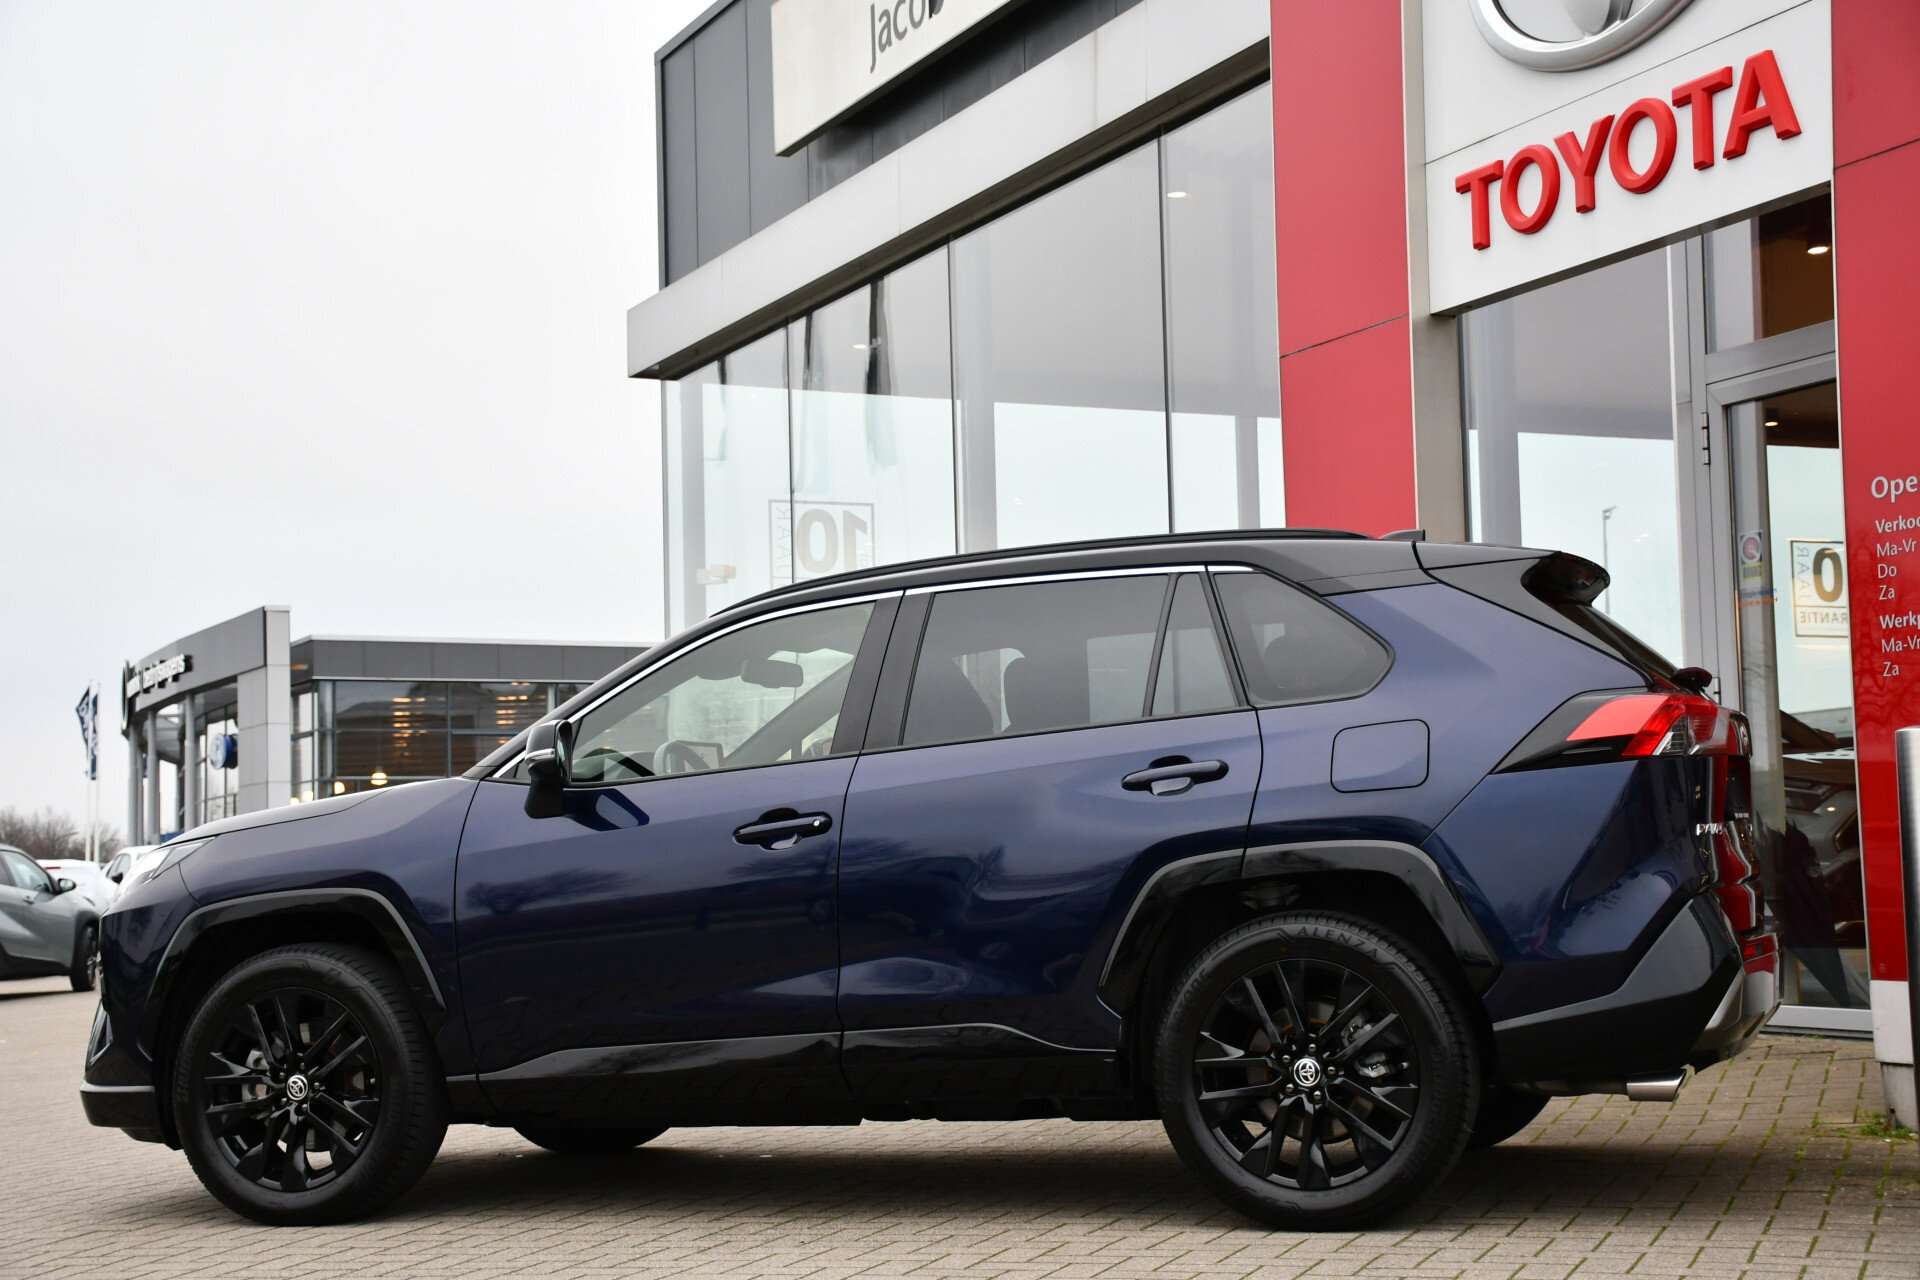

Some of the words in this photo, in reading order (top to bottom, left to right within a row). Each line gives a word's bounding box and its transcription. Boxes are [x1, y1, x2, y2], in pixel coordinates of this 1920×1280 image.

[1455, 49, 1802, 251] TOYOTA
[1871, 475, 1919, 503] Ope
[1877, 538, 1917, 558] Ma-Vr
[1878, 563, 1898, 579] Do
[1879, 584, 1896, 600] Za
[1881, 634, 1920, 653] Ma-Vr
[1883, 661, 1900, 677] Za
[1296, 925, 1380, 960] ALENZA
